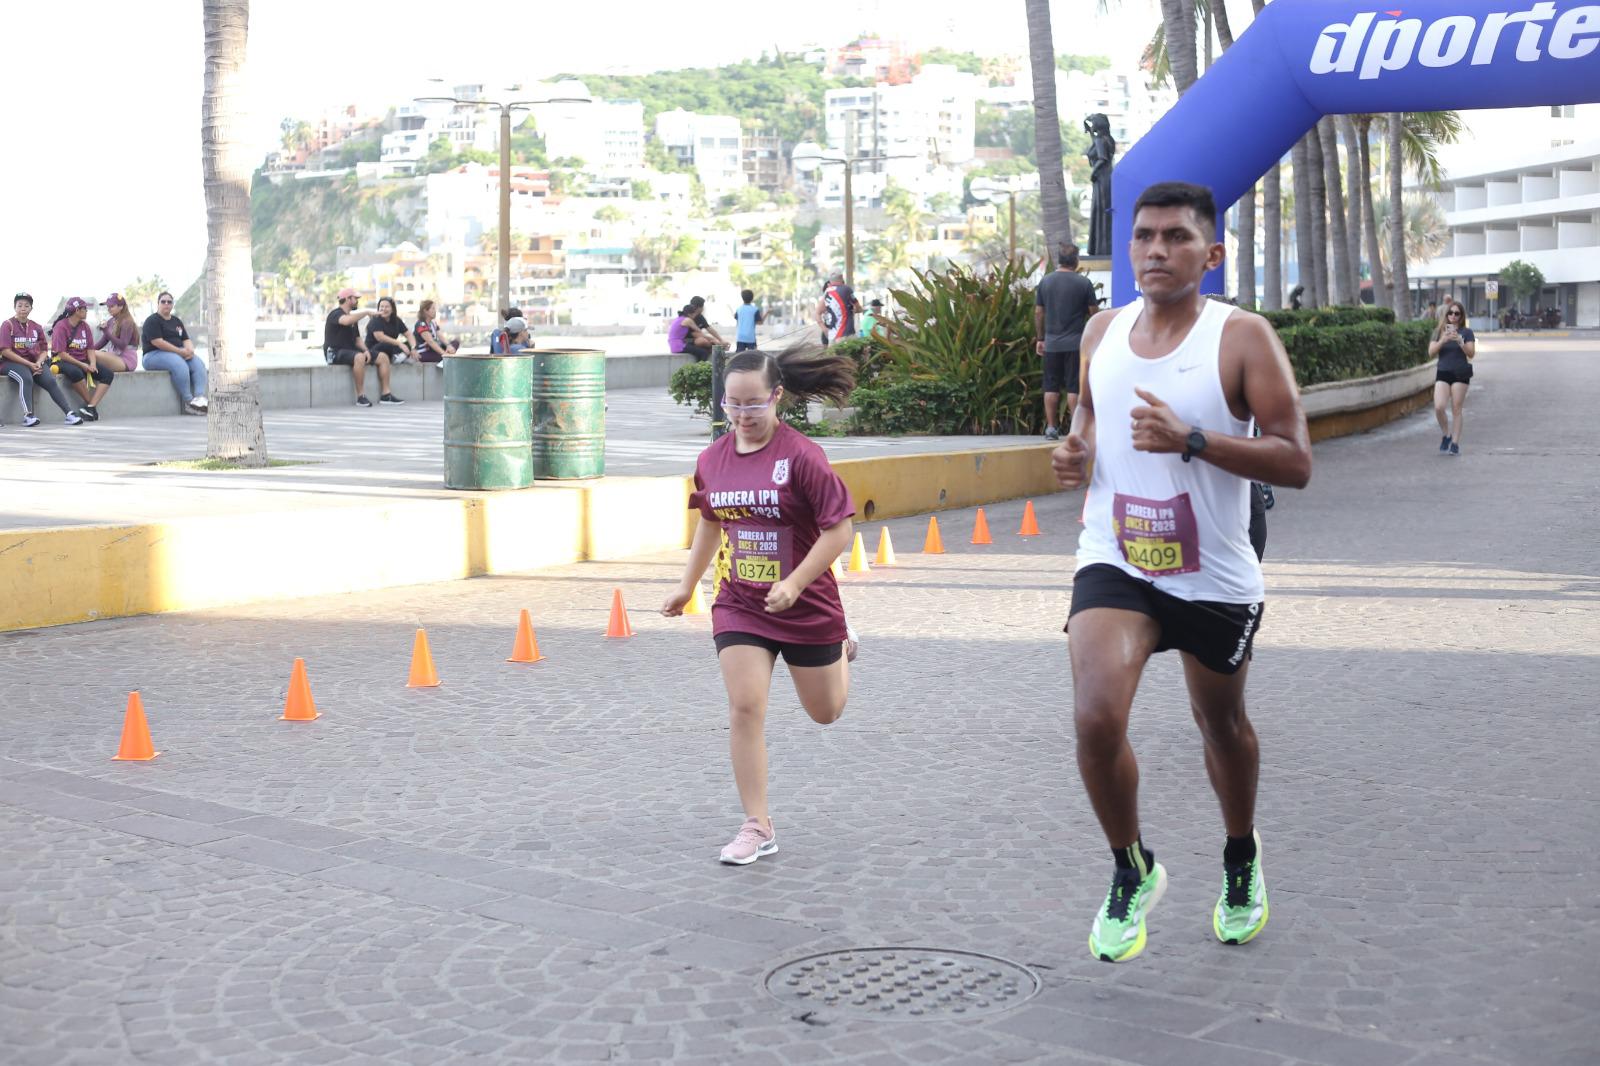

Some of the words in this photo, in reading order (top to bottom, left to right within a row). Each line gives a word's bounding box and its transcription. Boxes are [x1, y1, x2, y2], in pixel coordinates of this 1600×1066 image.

[710, 491, 756, 508] CARRERA
[759, 490, 779, 505] IPN
[740, 506, 752, 518] K
[750, 506, 781, 519] 2026
[1126, 503, 1158, 519] CARRERA
[1159, 507, 1175, 519] IPN
[1125, 517, 1143, 530] ONCE
[1144, 519, 1150, 531] K
[1151, 520, 1176, 532] 2026
[738, 530, 765, 541] CARRERA
[766, 531, 778, 541] IPN
[738, 541, 753, 550] ONCE
[753, 541, 758, 551] K
[759, 541, 778, 551] 2026
[1128, 545, 1177, 567] 0409
[739, 562, 777, 579] 0374
